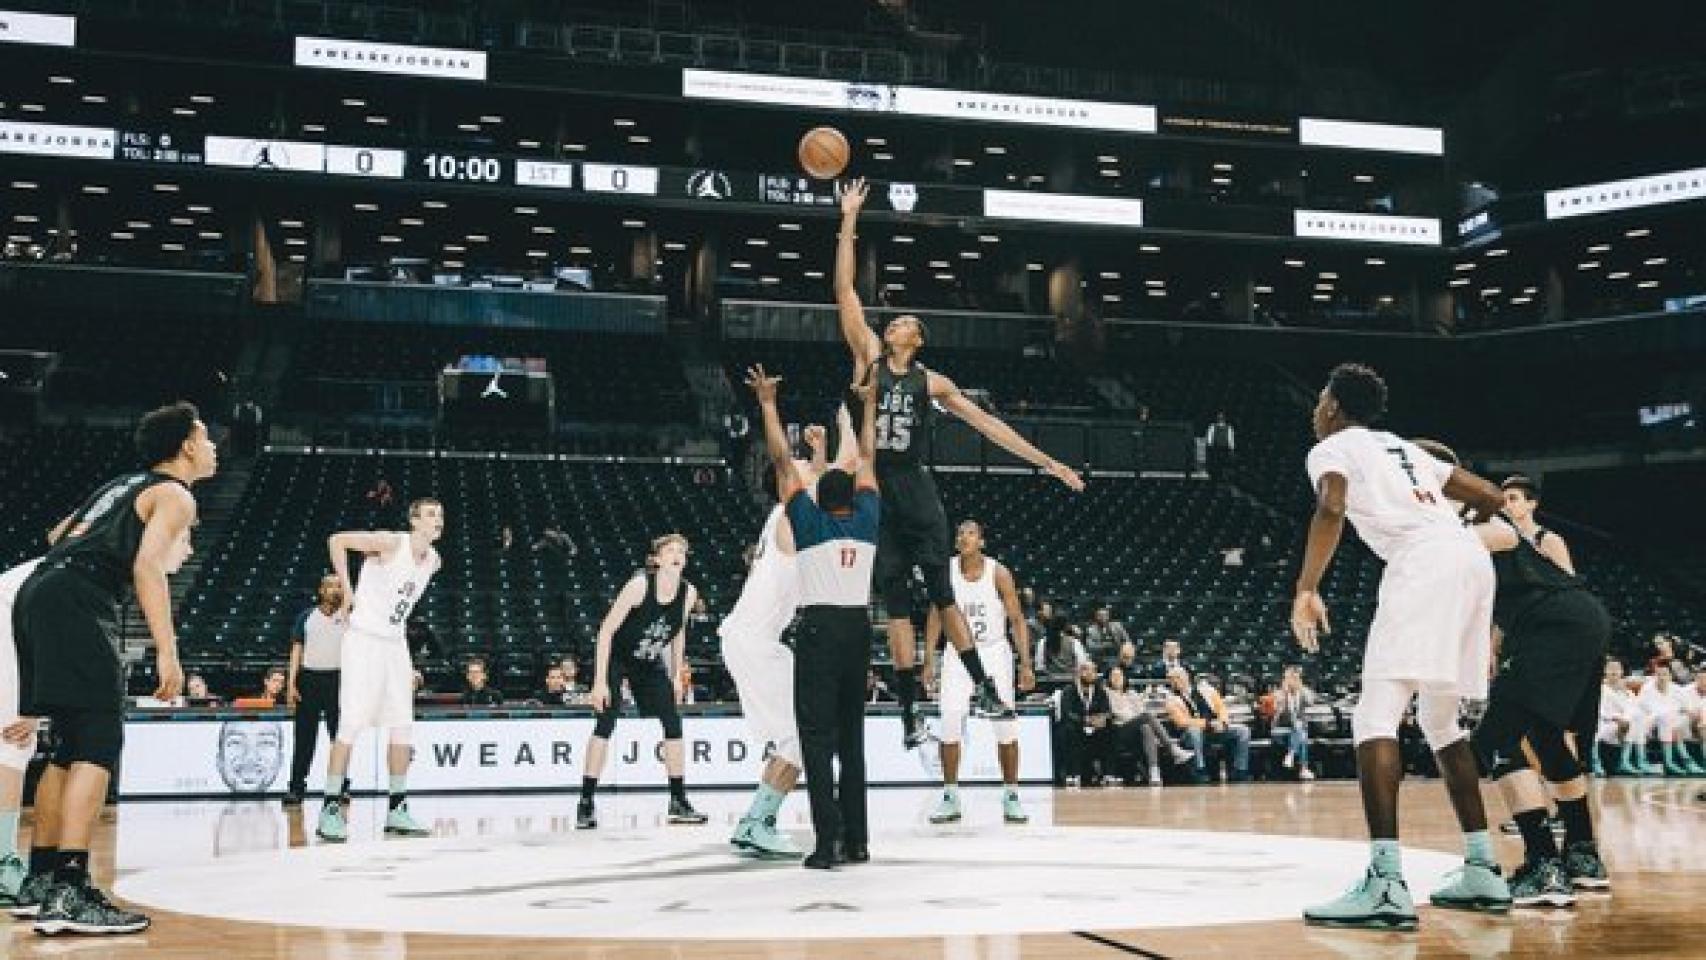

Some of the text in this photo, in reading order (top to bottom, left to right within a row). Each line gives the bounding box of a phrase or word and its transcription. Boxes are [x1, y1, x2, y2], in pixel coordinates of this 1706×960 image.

[355, 150, 373, 174] 0
[424, 153, 500, 182] 10:00
[611, 168, 627, 191] 0
[876, 415, 914, 453] 15
[840, 547, 857, 569] 17
